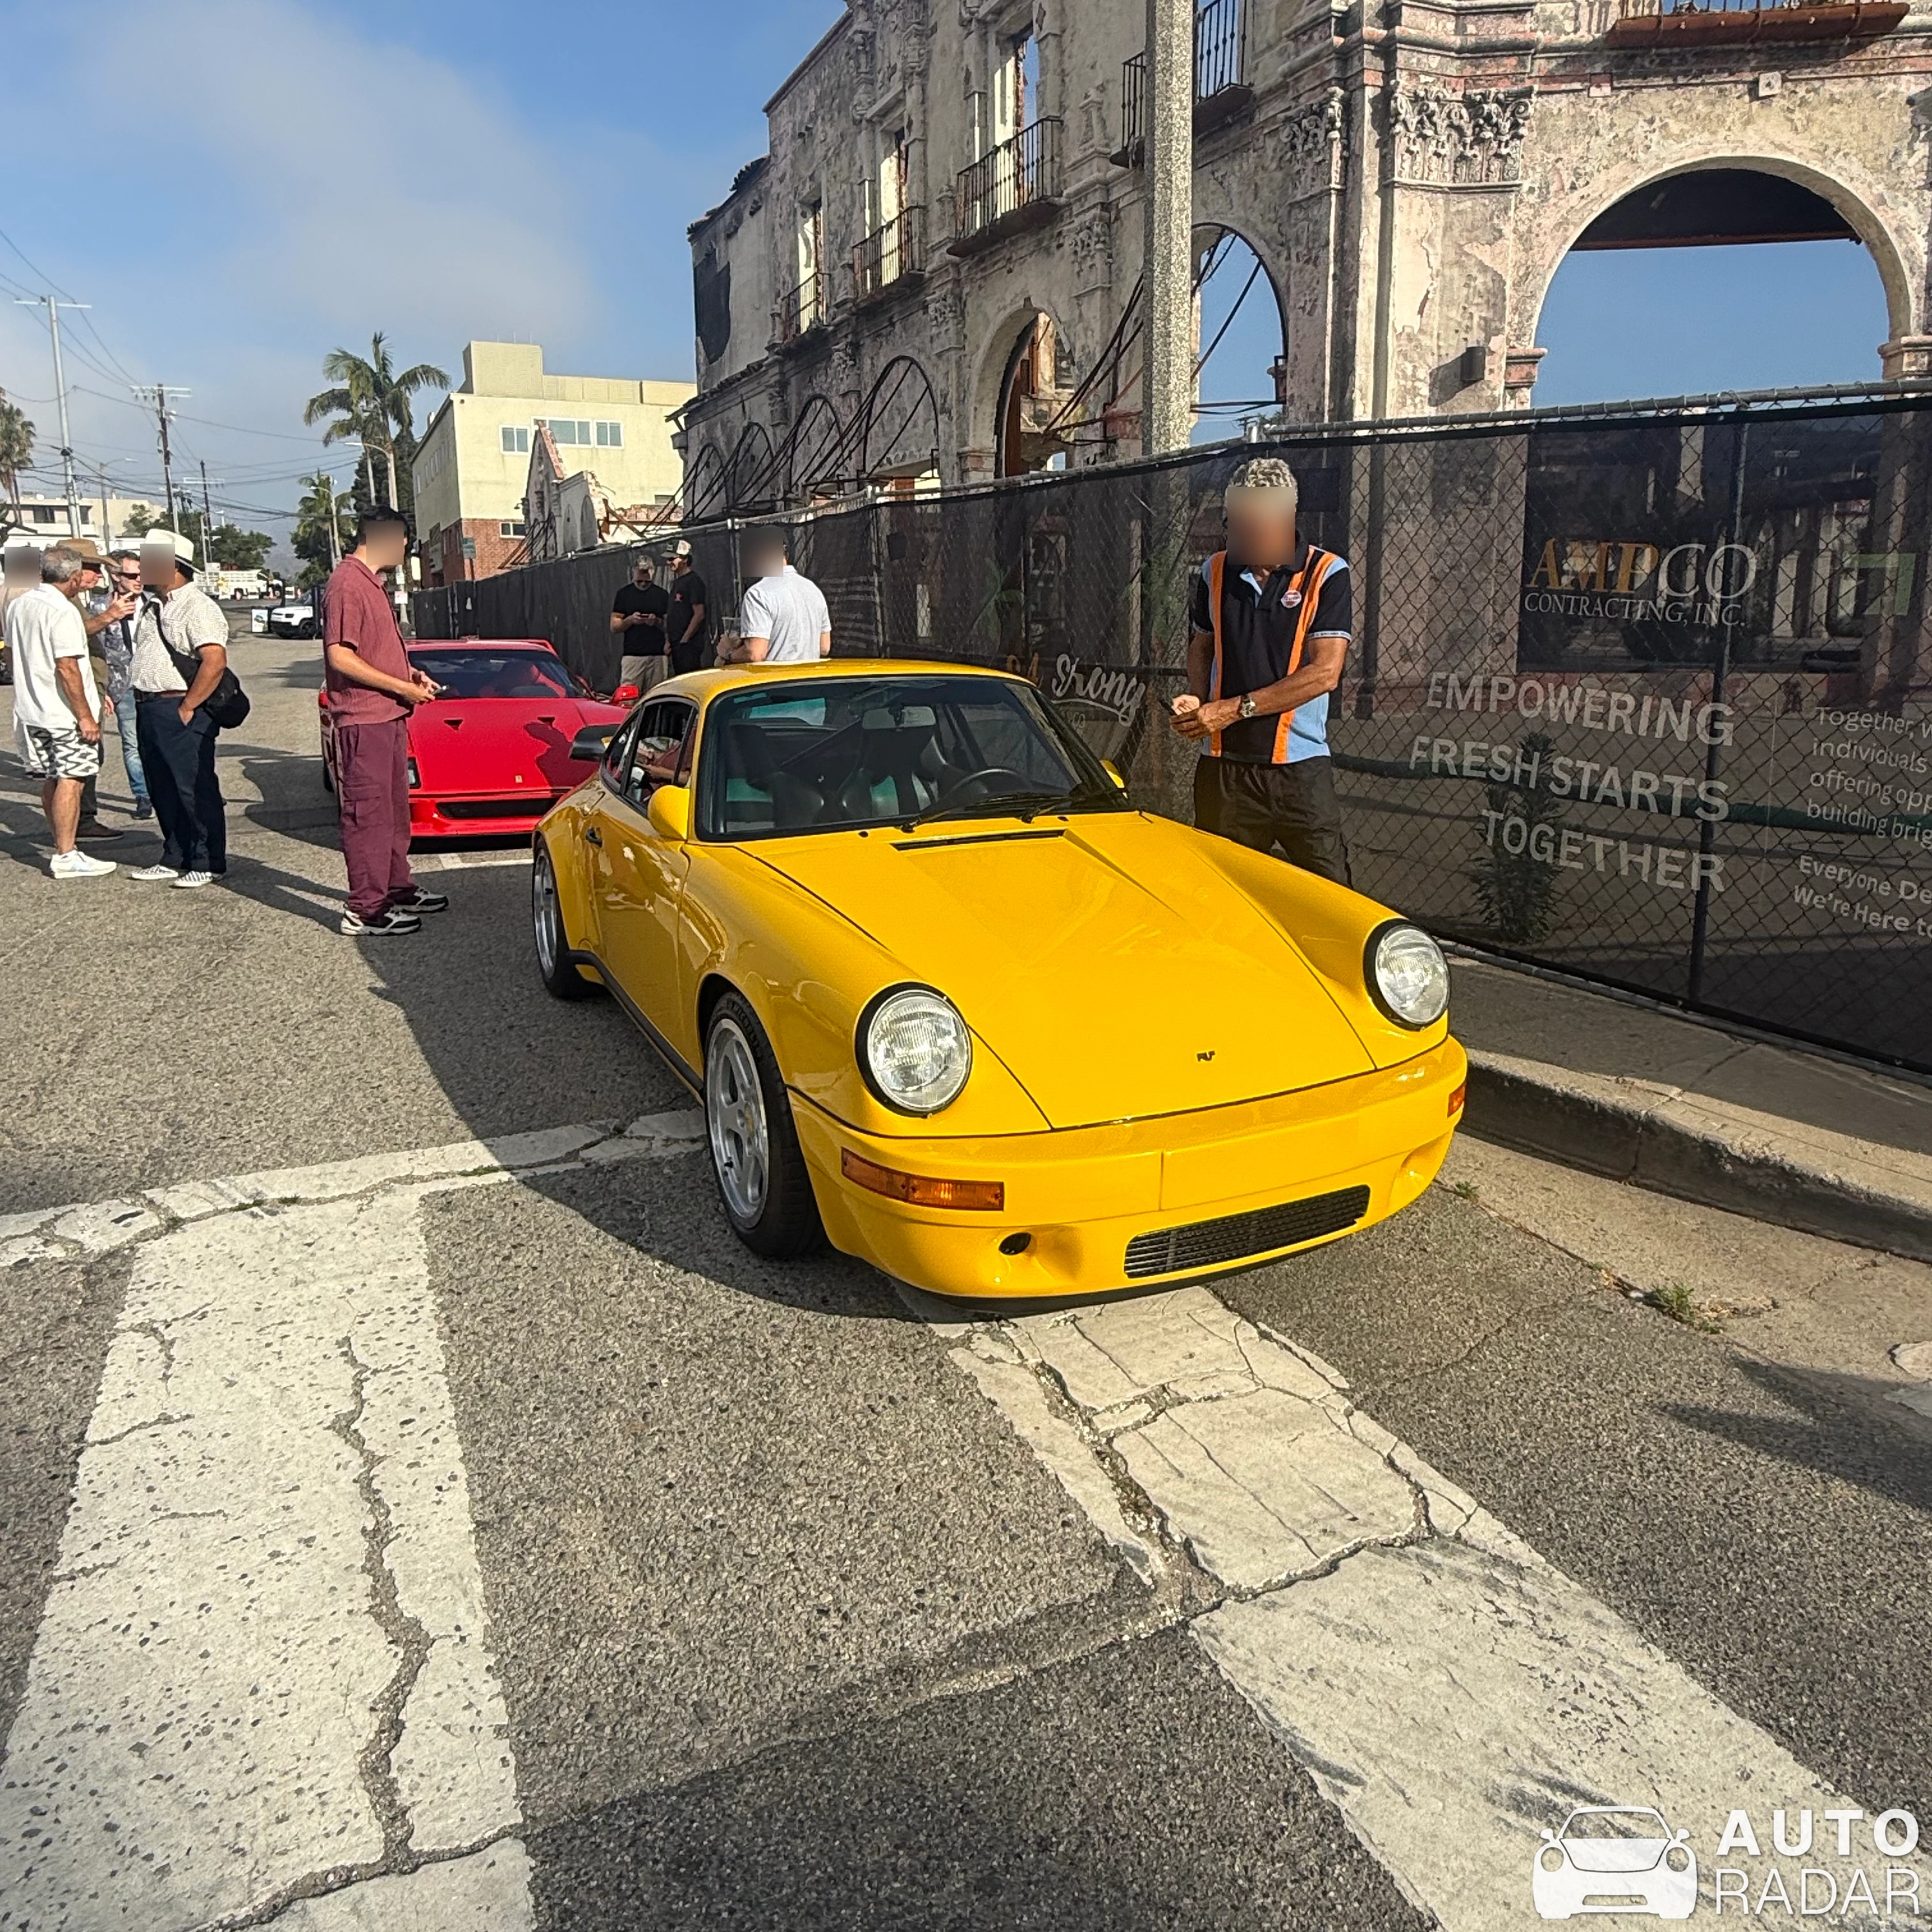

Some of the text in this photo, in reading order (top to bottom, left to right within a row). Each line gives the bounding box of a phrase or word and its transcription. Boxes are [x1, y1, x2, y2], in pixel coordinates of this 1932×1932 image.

[1526, 537, 1757, 599] AMPCO
[1524, 593, 1745, 627] CONTRACTING, INC.
[1052, 654, 1146, 726] Strong
[1427, 672, 1735, 746] EMPOWERING
[1815, 707, 1914, 739] Together,
[1813, 738, 1928, 773] individuals
[1409, 736, 1729, 822] FRESH STARTS
[1810, 769, 1894, 805] offering
[1807, 799, 1888, 838] building
[1482, 809, 1725, 892] TOGETHER
[1800, 855, 1891, 896] Everyone
[1794, 885, 1850, 917] We're
[1854, 902, 1910, 931] Here
